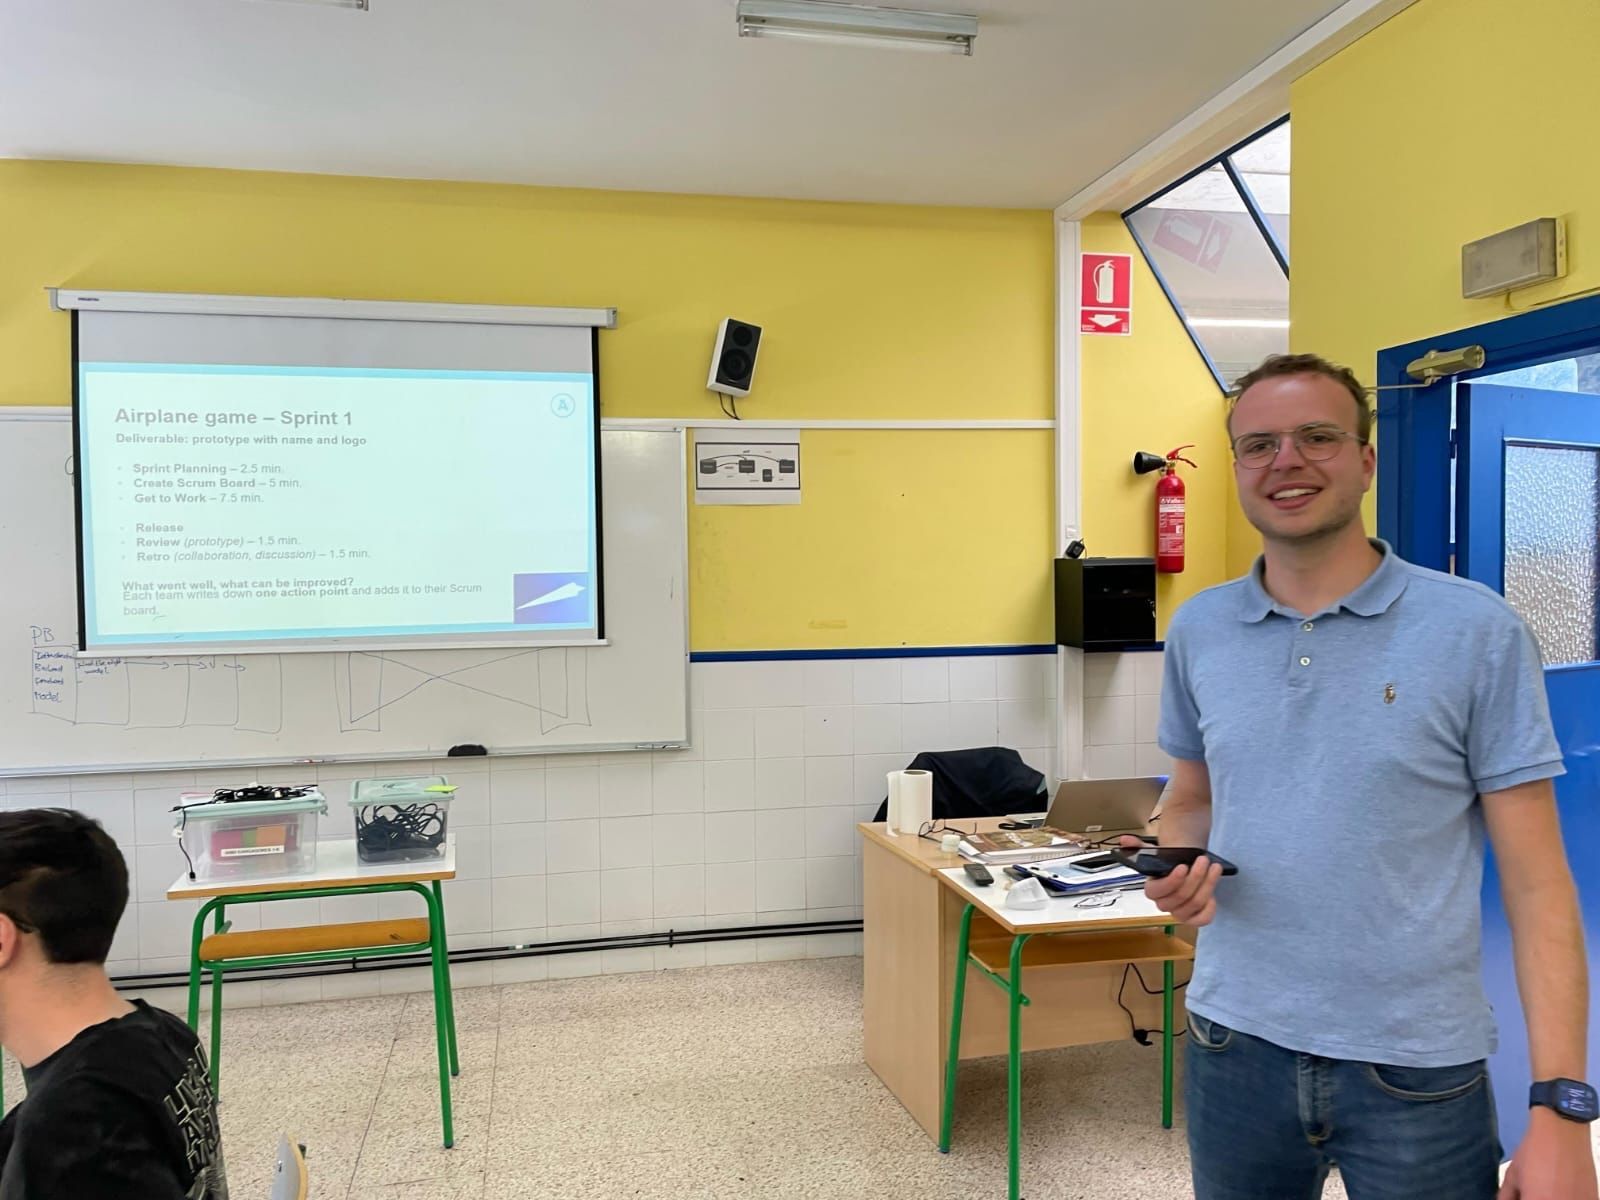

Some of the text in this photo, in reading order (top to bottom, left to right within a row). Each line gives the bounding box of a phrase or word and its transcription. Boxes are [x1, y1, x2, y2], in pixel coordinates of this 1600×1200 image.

[115, 408, 198, 427] Airplane
[205, 412, 257, 427] game
[280, 410, 338, 428] Sprint
[343, 411, 351, 425] 1
[116, 433, 367, 447] Deliverable: prototype with name and logo
[133, 463, 170, 475] Sprint
[174, 463, 227, 476] Planning
[240, 463, 258, 474] 2.5
[133, 478, 174, 488] Create
[177, 478, 216, 488] Scrum
[220, 478, 256, 488] Board
[269, 478, 277, 488] 5
[279, 479, 302, 489] min.
[134, 493, 156, 503] Get
[159, 493, 171, 503] to
[174, 493, 206, 503] Work
[220, 493, 237, 503] 7.5
[240, 494, 264, 503] min.
[136, 523, 184, 533] Release
[136, 537, 181, 547] Review
[183, 536, 244, 549] (prototype)
[258, 536, 275, 546] 1.5
[137, 552, 170, 561] Retro
[174, 550, 252, 563] (collaboration,
[255, 550, 316, 561] discussion)
[330, 549, 346, 559] 1.5
[122, 577, 354, 591] What went well, what can be improved?
[122, 583, 482, 601] Each team writes down one action point and adds it to their Scrum
[123, 606, 160, 616] board.
